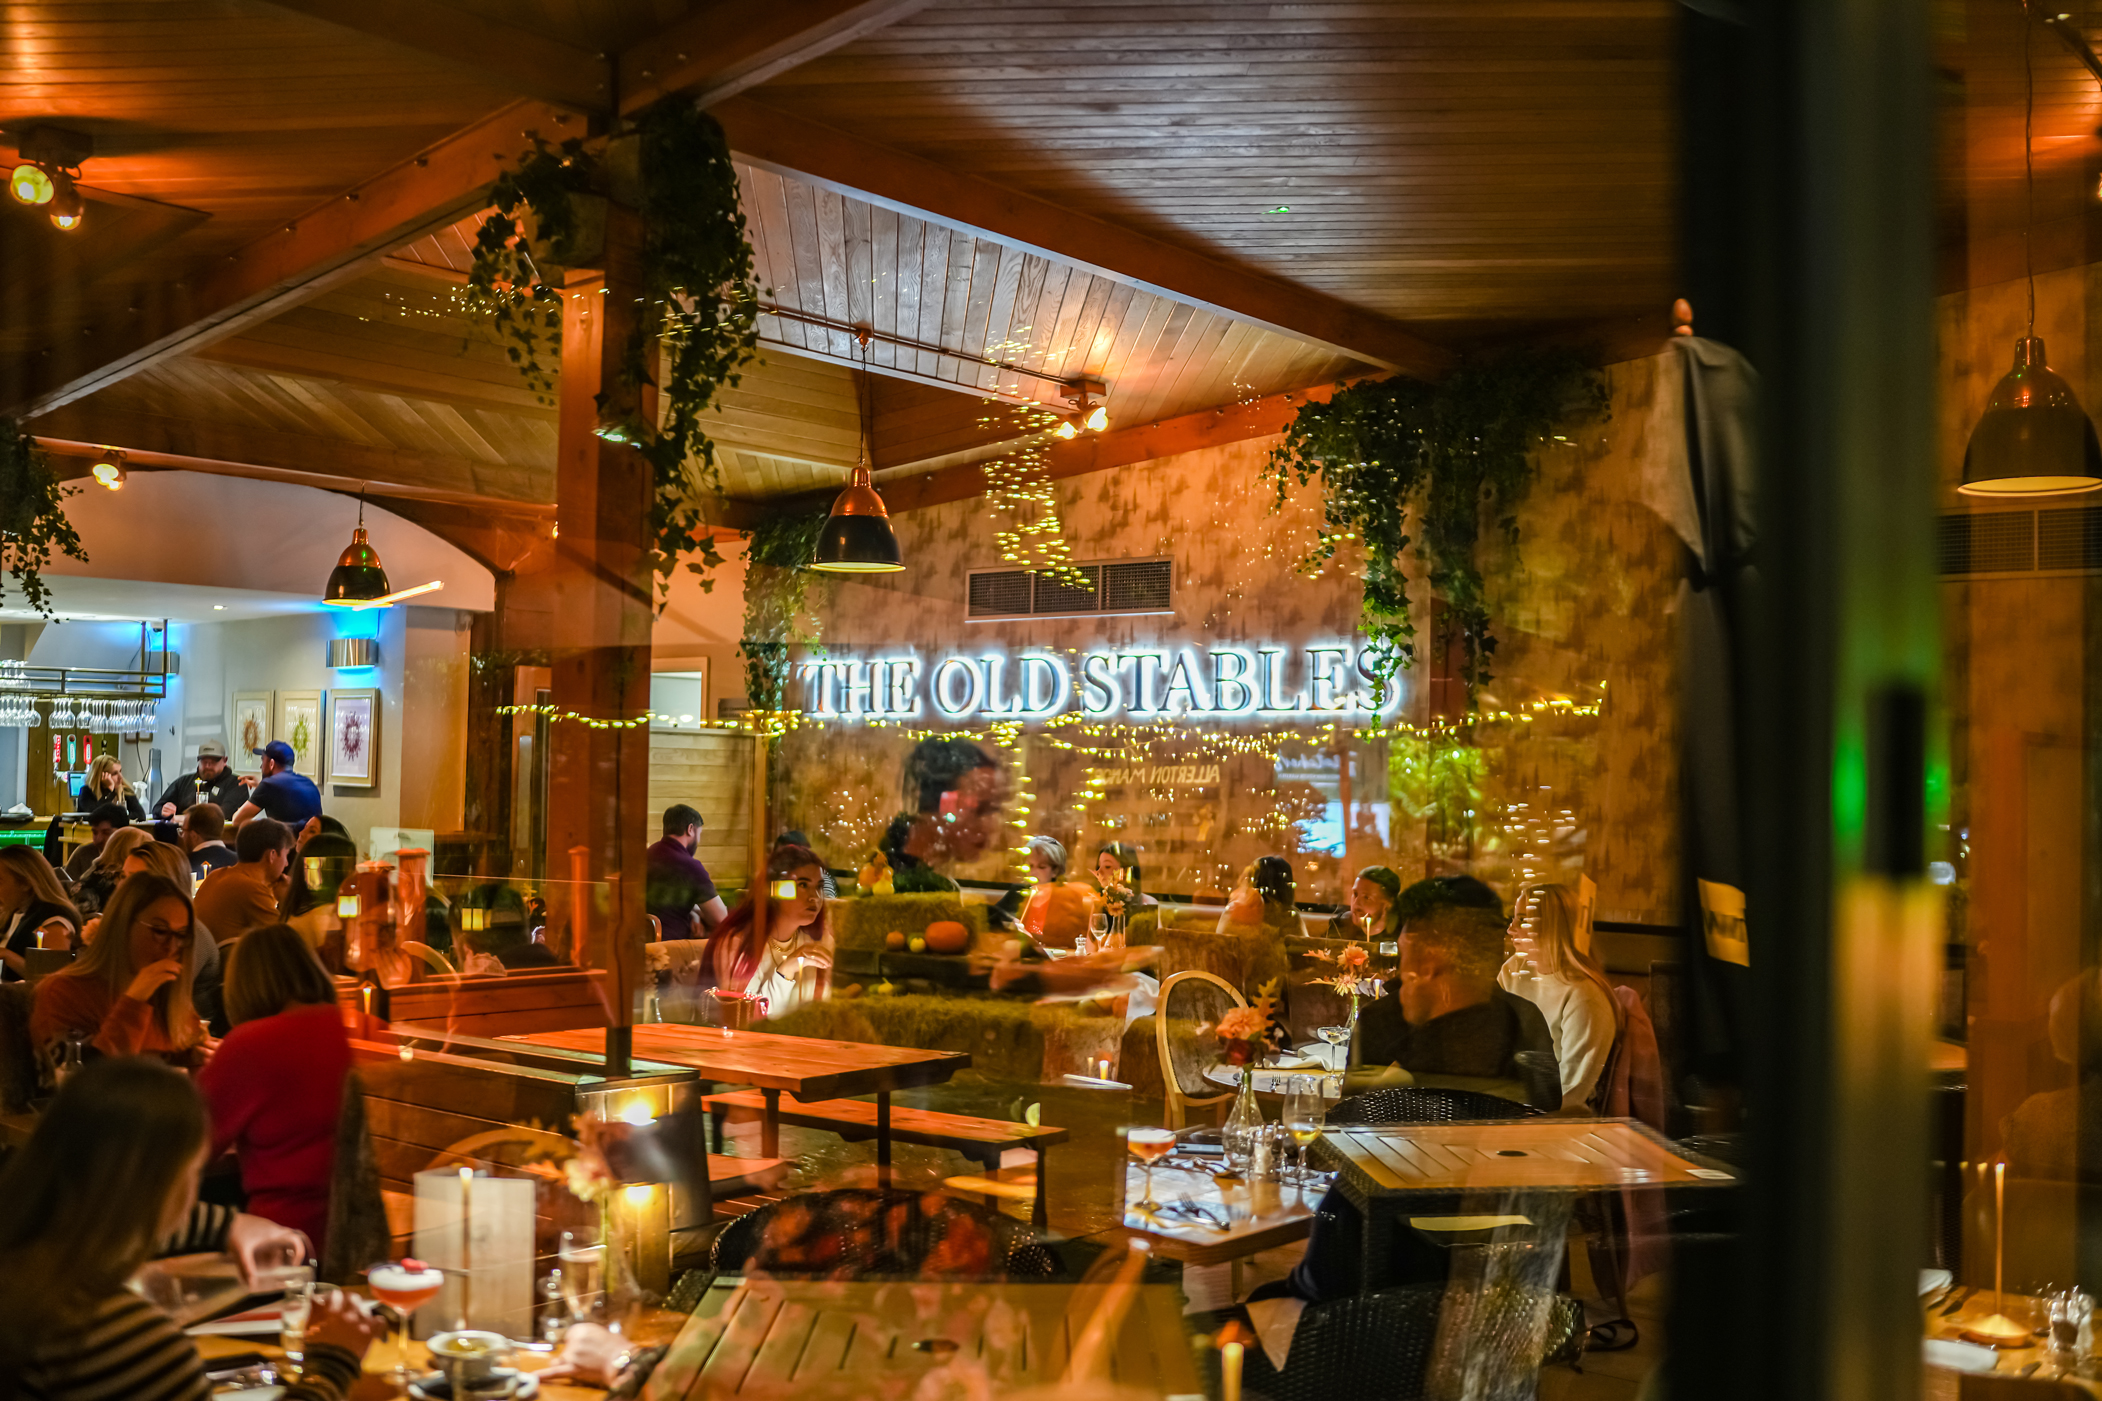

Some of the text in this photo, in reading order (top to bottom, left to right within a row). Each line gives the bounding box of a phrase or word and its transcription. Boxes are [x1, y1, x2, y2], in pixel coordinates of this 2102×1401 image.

[798, 646, 1398, 717] THE OLD STABLES
